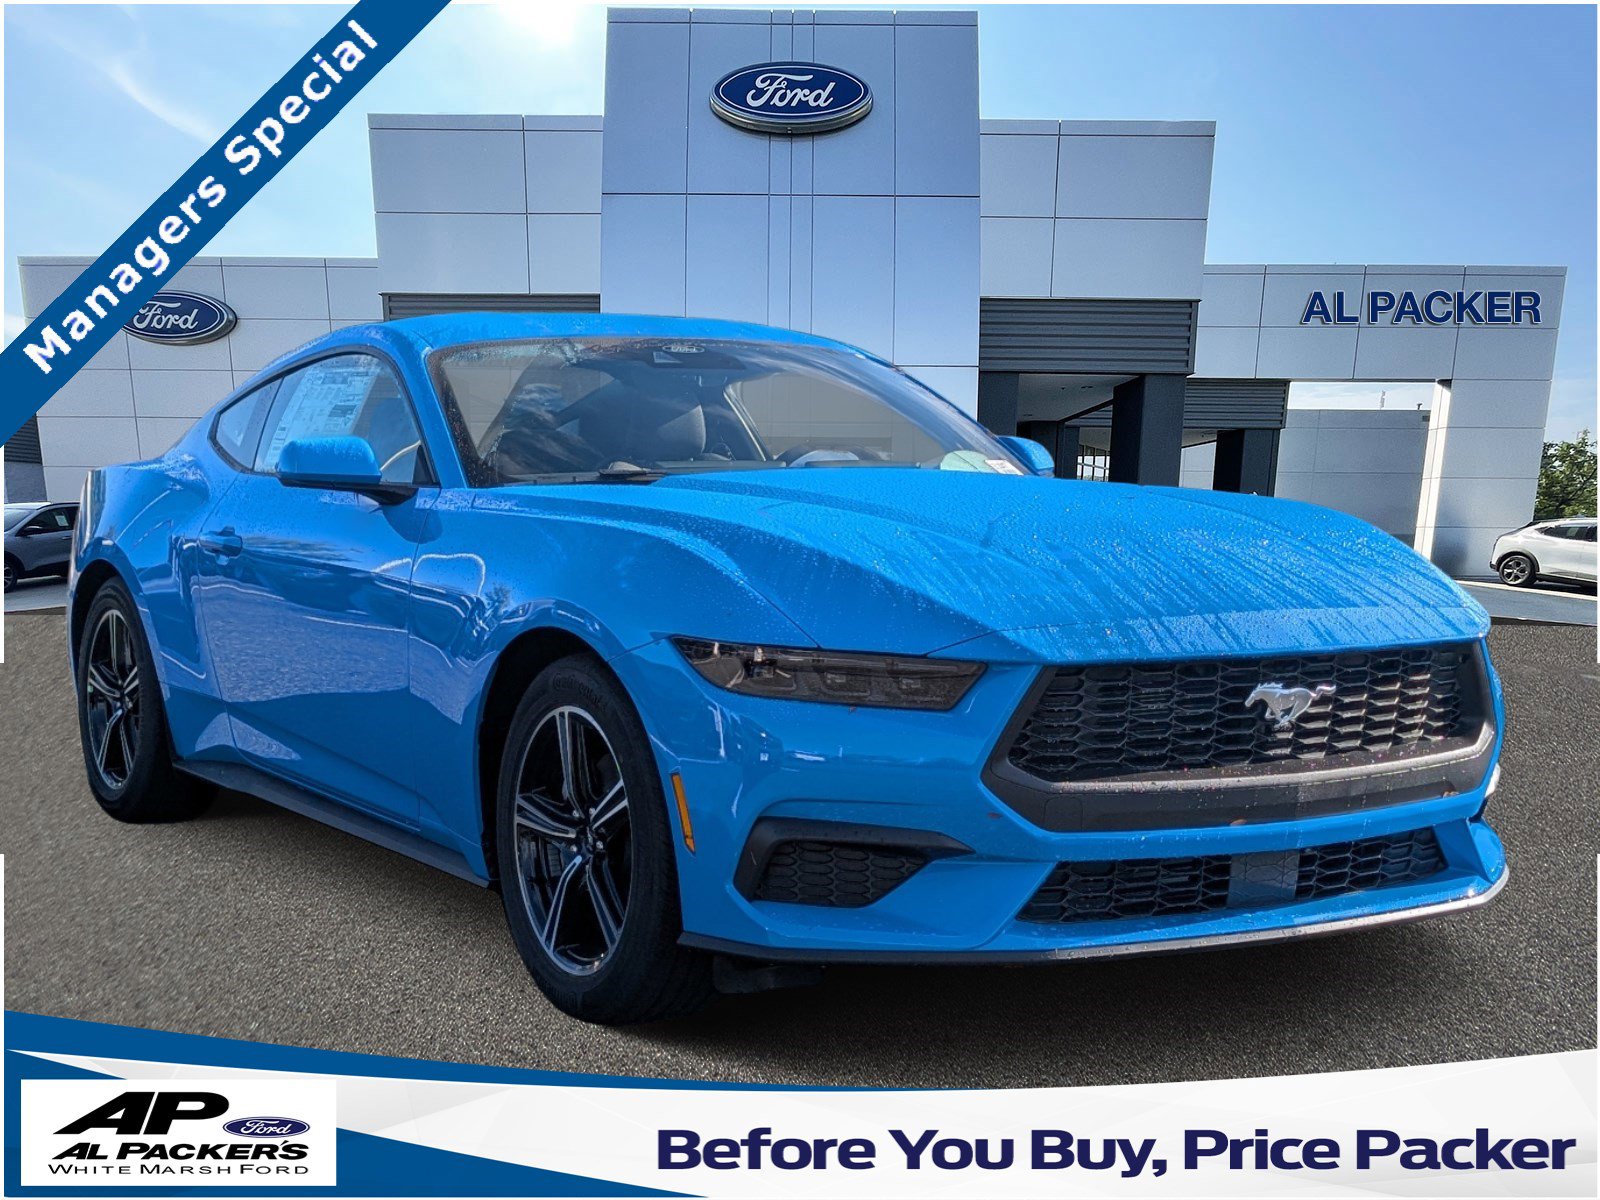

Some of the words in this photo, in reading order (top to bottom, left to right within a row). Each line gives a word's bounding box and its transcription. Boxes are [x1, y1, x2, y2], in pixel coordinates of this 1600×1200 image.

[746, 73, 836, 107] Ford
[133, 301, 199, 329] Ford
[1303, 290, 1359, 324] AL
[1369, 290, 1542, 325] PACKER
